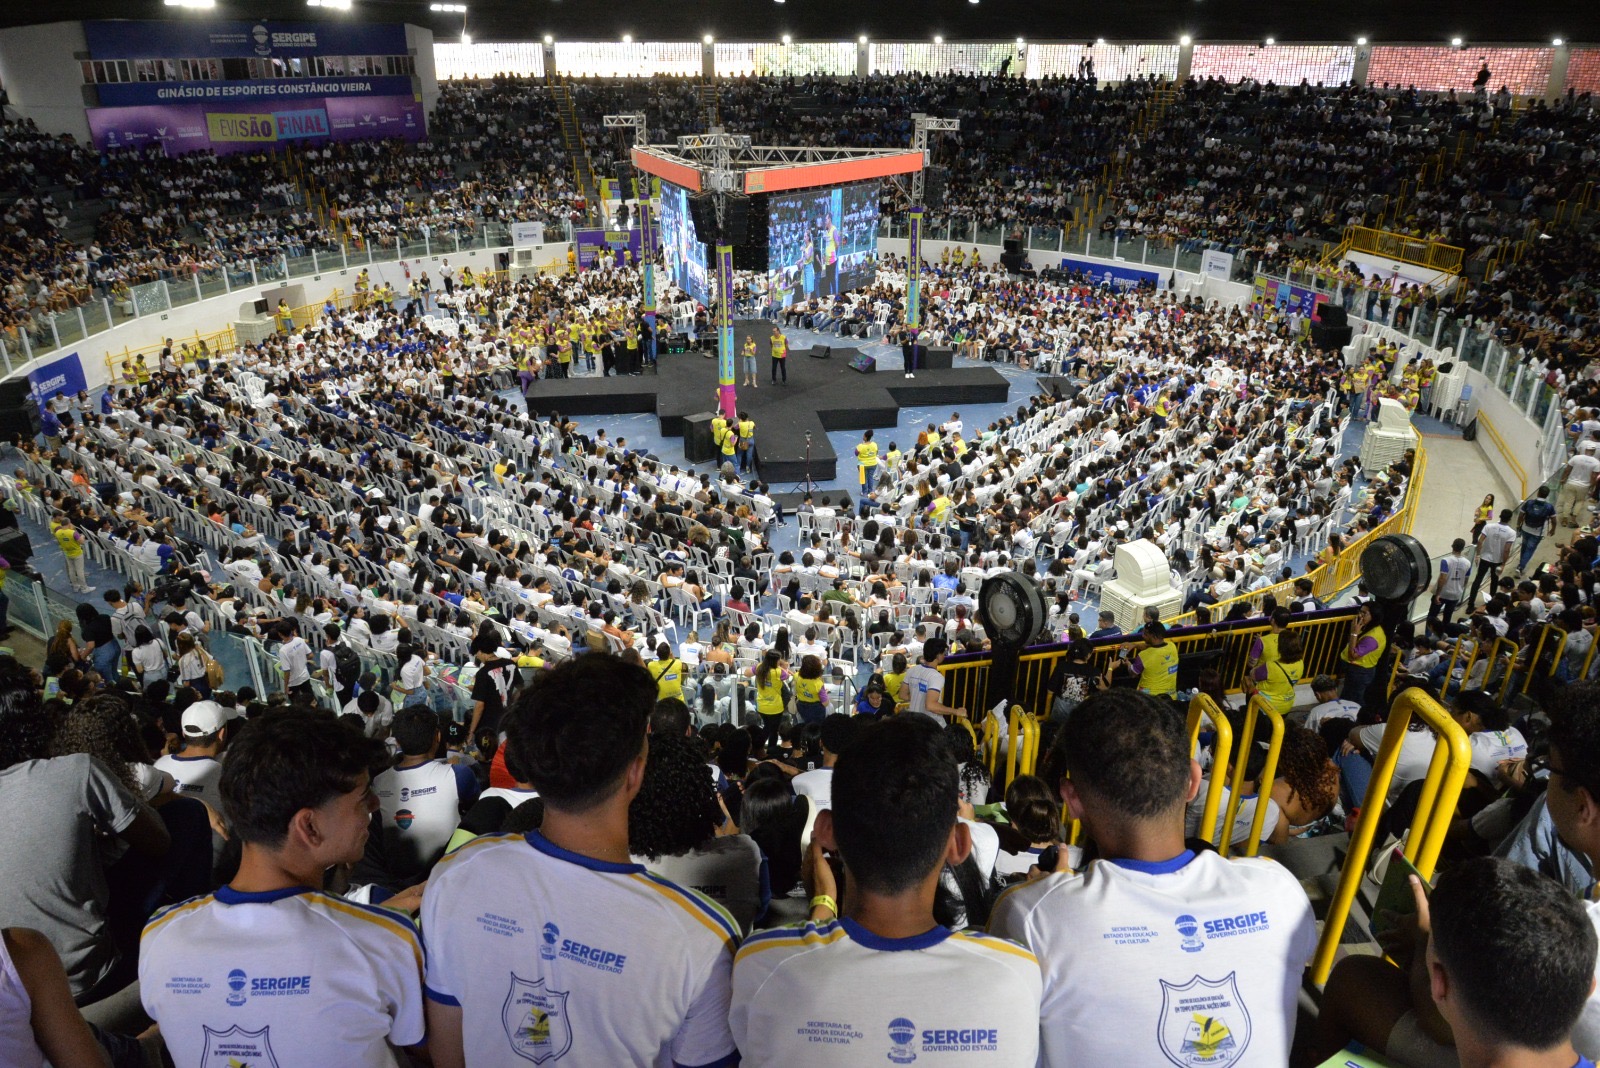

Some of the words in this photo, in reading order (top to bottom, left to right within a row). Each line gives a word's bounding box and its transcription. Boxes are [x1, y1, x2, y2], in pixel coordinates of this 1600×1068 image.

[272, 32, 316, 42] SERGIPE
[158, 86, 204, 98] GINÁSIO
[206, 87, 220, 96] DE
[222, 85, 276, 96] ESPORTES
[278, 82, 339, 94] CONSTÂNCIO
[340, 82, 372, 92] VIEIRA
[277, 116, 326, 134] FINAL
[39, 374, 66, 391] SERGIPE
[411, 786, 437, 795] SERGIPE
[485, 913, 510, 924] SECRETARIA
[1203, 911, 1268, 933] SERGIPE
[1207, 931, 1237, 940] GOVERNO
[1248, 924, 1269, 933] ESTADO
[561, 939, 627, 968] SERGIPE
[559, 951, 587, 965] GOVERNO
[598, 963, 622, 974] ESTADO
[251, 976, 311, 990] SERGIPE
[830, 1030, 863, 1039] EDUCAÇÃO
[922, 1029, 997, 1044] SERGIPE
